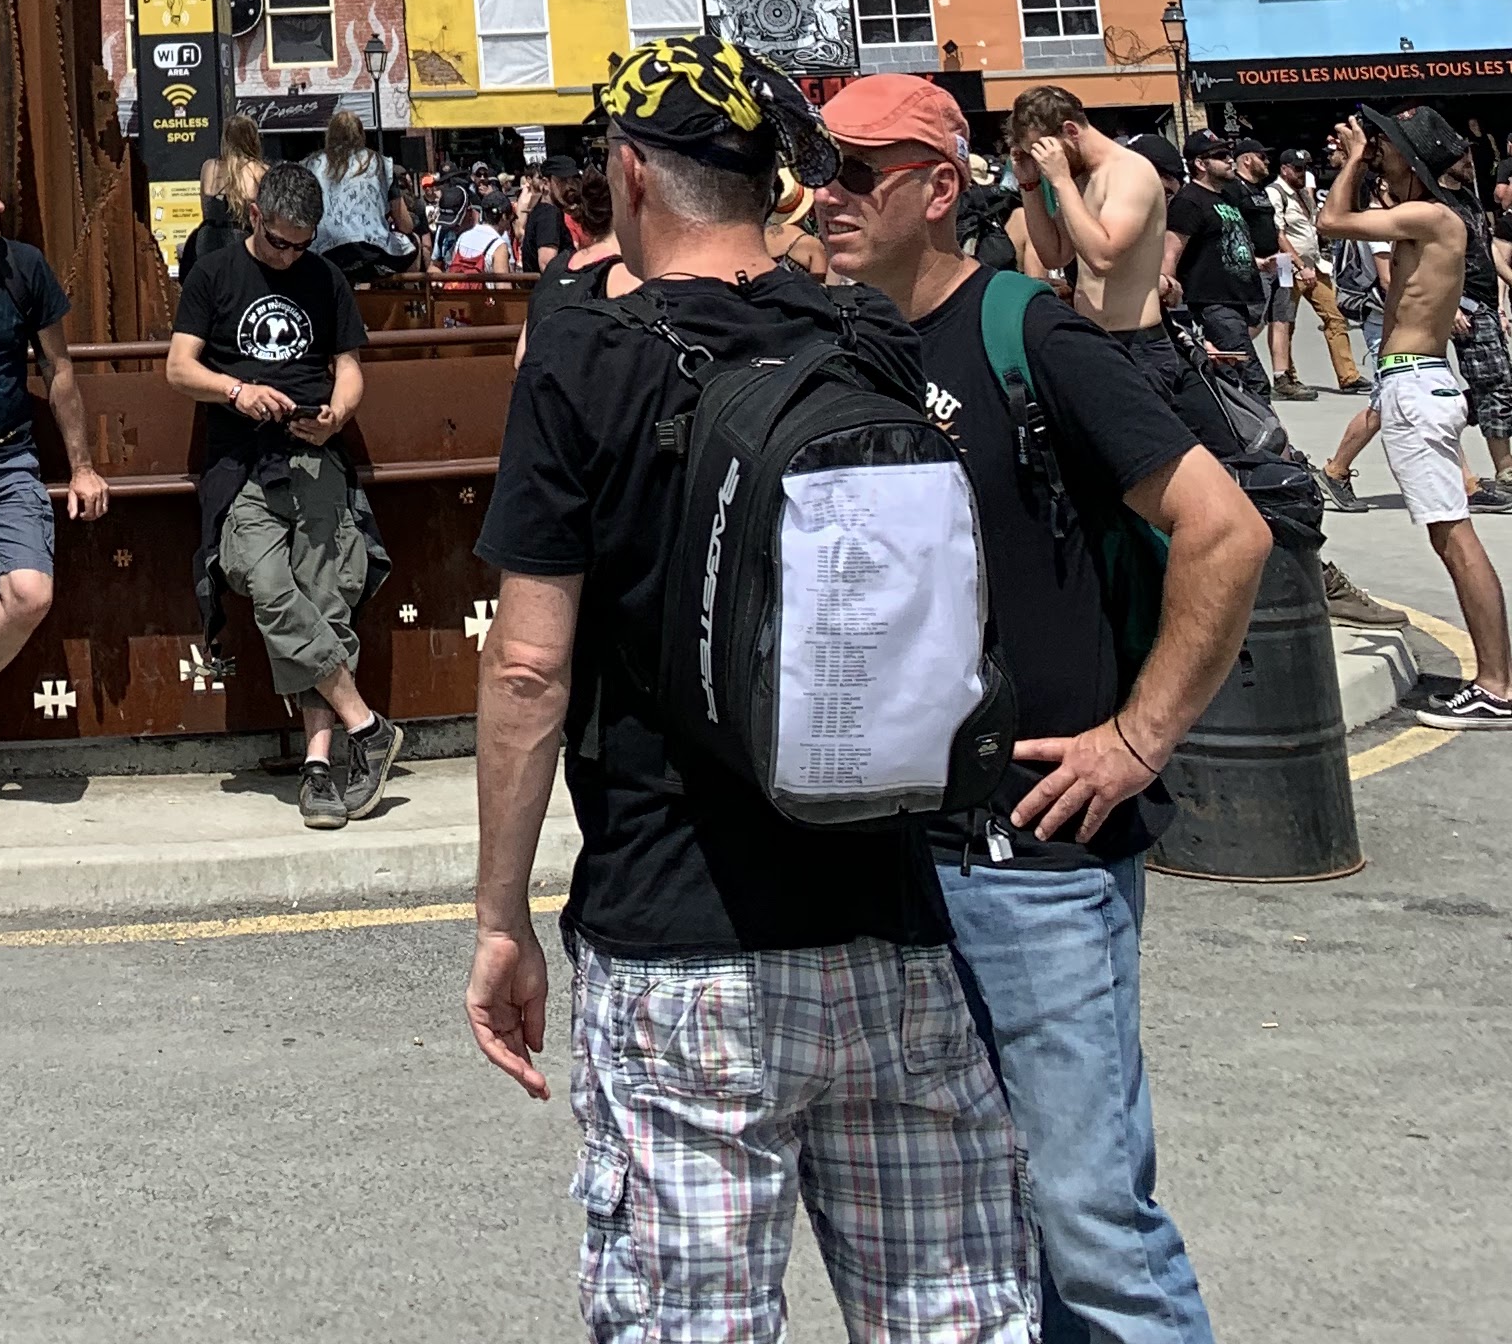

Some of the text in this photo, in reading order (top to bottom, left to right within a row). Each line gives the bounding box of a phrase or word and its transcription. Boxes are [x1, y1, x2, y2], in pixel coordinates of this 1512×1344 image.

[167, 68, 190, 77] AREA
[1237, 69, 1300, 85] TOUTES
[1302, 67, 1330, 83] LES
[1334, 65, 1426, 83] MUSIQUES,
[1426, 62, 1472, 77] TOUS
[1476, 60, 1504, 75] LES
[153, 117, 209, 129] CASHLESS
[167, 132, 196, 143] SPOT
